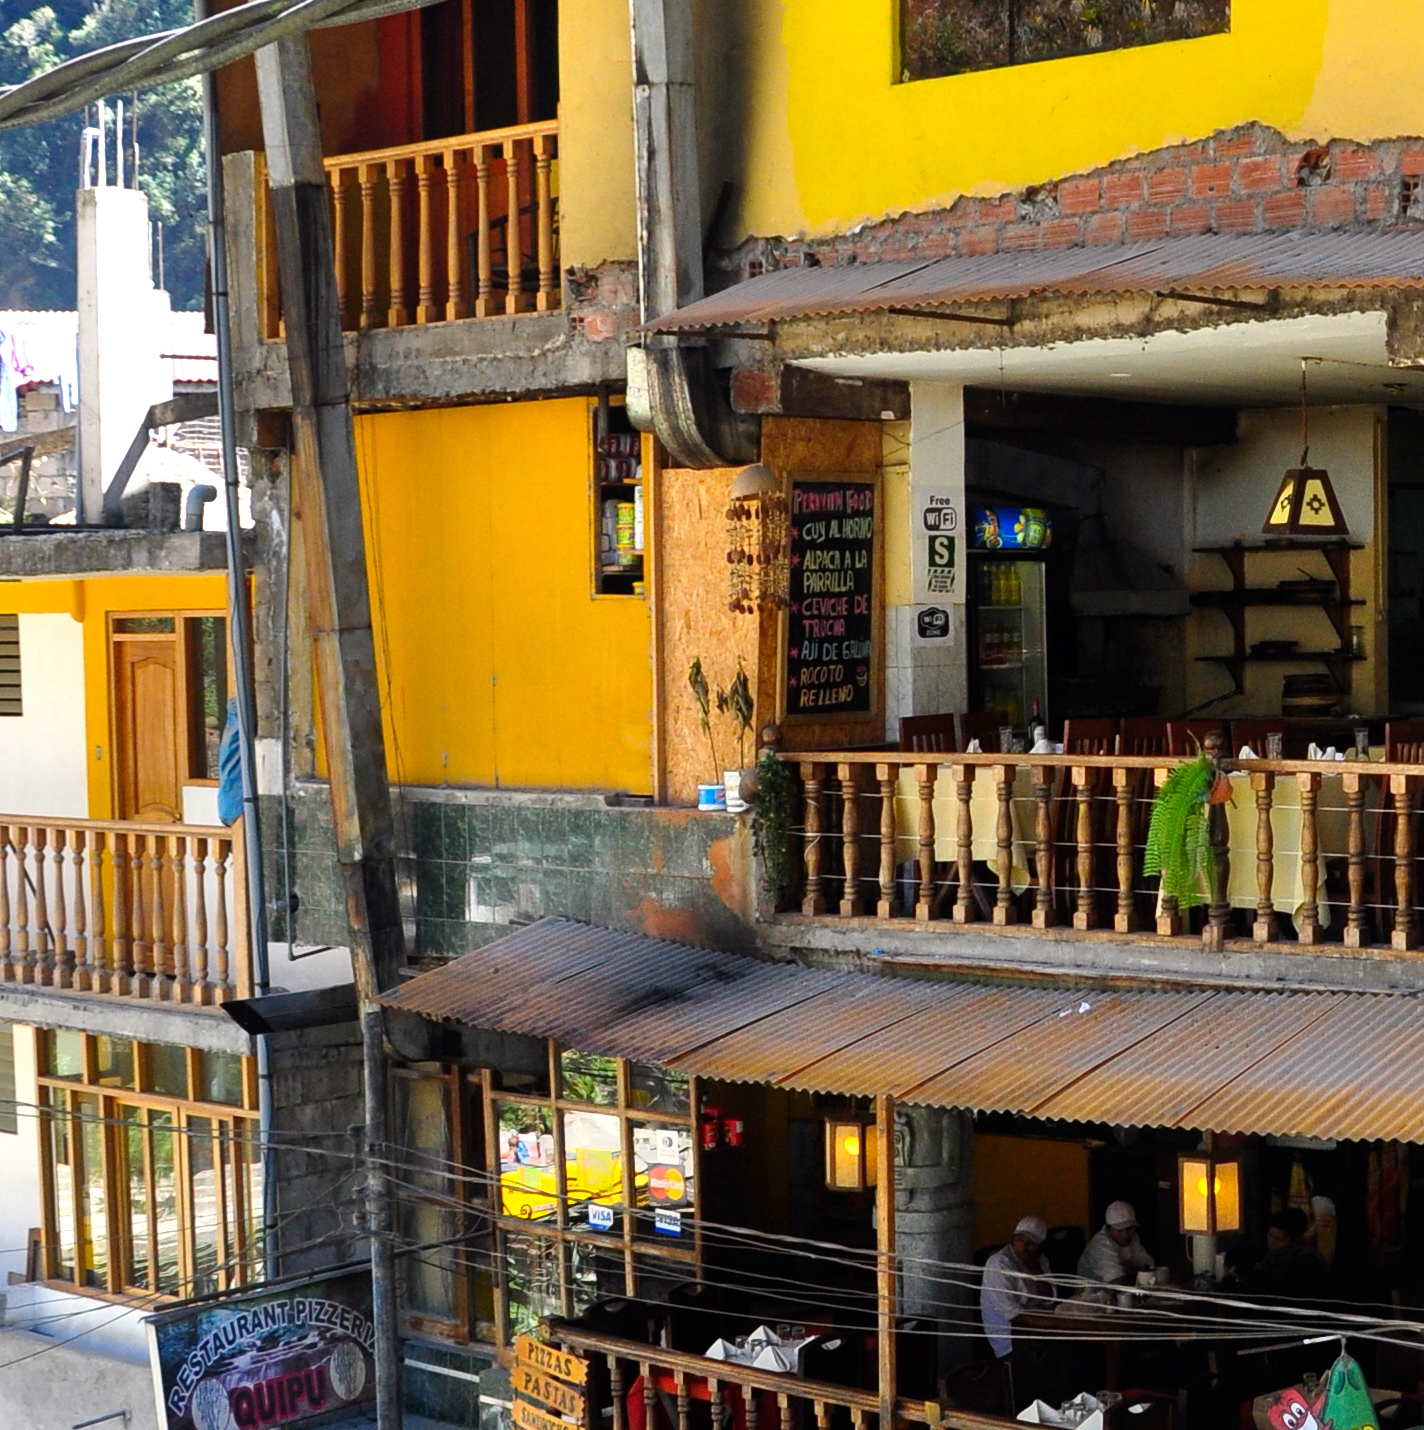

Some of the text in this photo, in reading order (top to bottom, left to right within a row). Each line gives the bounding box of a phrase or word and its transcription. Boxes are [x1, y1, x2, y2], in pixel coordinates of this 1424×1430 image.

[847, 489, 872, 513] FOOD
[930, 496, 951, 505] Free
[829, 520, 842, 539] AL
[803, 549, 867, 570] ALPACA A LA
[935, 537, 949, 565] S
[803, 570, 854, 594] PARRILLA
[802, 594, 868, 616] CEVICHE DE
[803, 619, 845, 638] TRUCHA
[823, 643, 839, 661] DE
[800, 664, 844, 686] ROCOTO
[800, 685, 854, 708] RELLENO
[591, 1209, 612, 1223] VISA
[168, 1299, 291, 1417] RESTAURANT
[528, 1342, 573, 1377] PIZZAS
[232, 1365, 327, 1430] QUIPU
[524, 1372, 576, 1413] PASTAS
